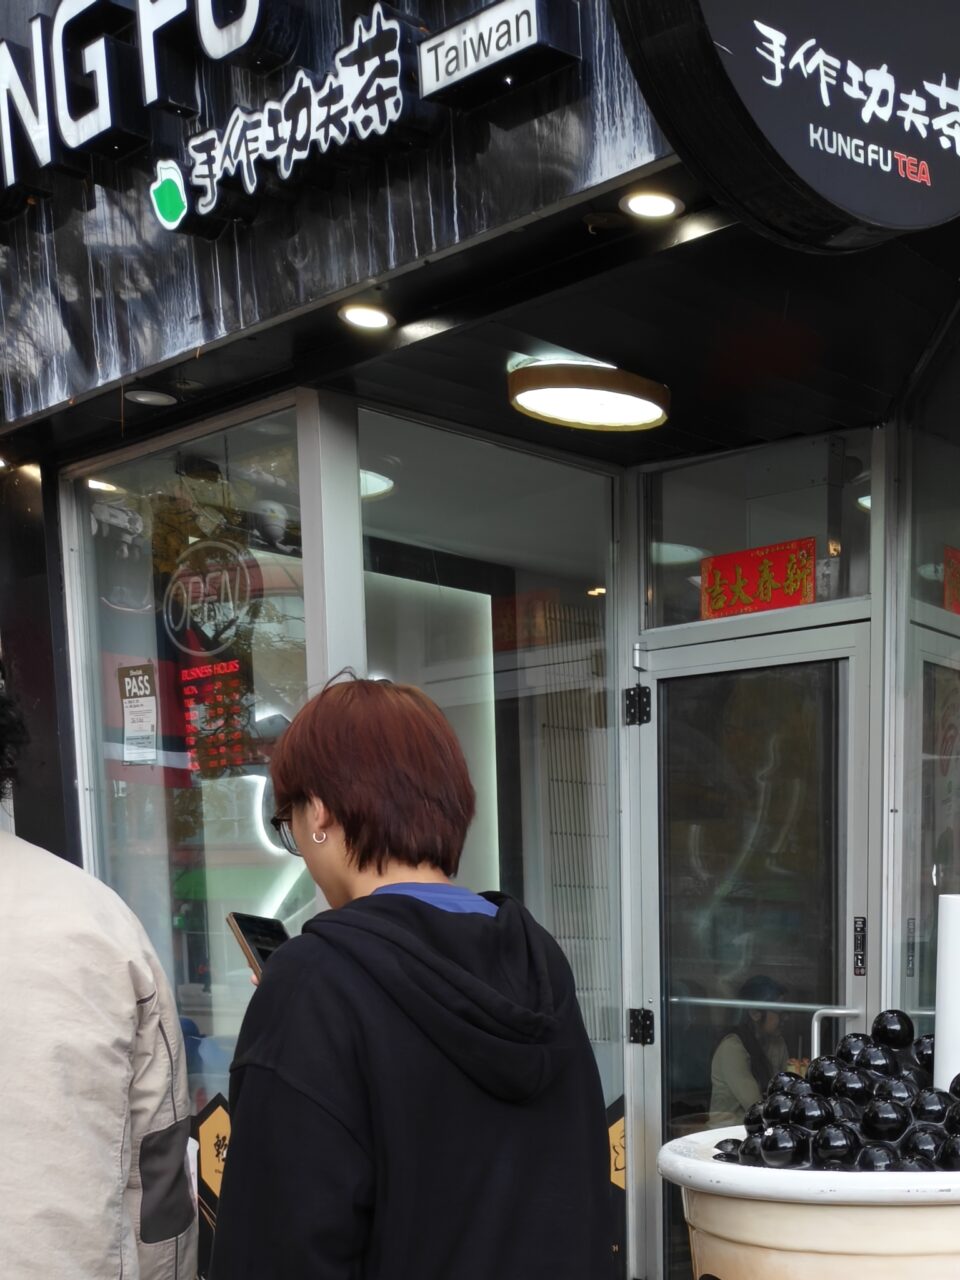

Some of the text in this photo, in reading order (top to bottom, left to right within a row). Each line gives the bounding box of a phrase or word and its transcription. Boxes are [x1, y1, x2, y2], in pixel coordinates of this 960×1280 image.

[426, 8, 533, 83] Taiwan
[190, 10, 401, 213] 手作功夫茶
[809, 123, 865, 164] KUNG
[893, 151, 931, 187] TEA
[168, 566, 241, 632] OPEN
[124, 675, 151, 697] PASS
[181, 660, 240, 681] BUSINESS HOURS
